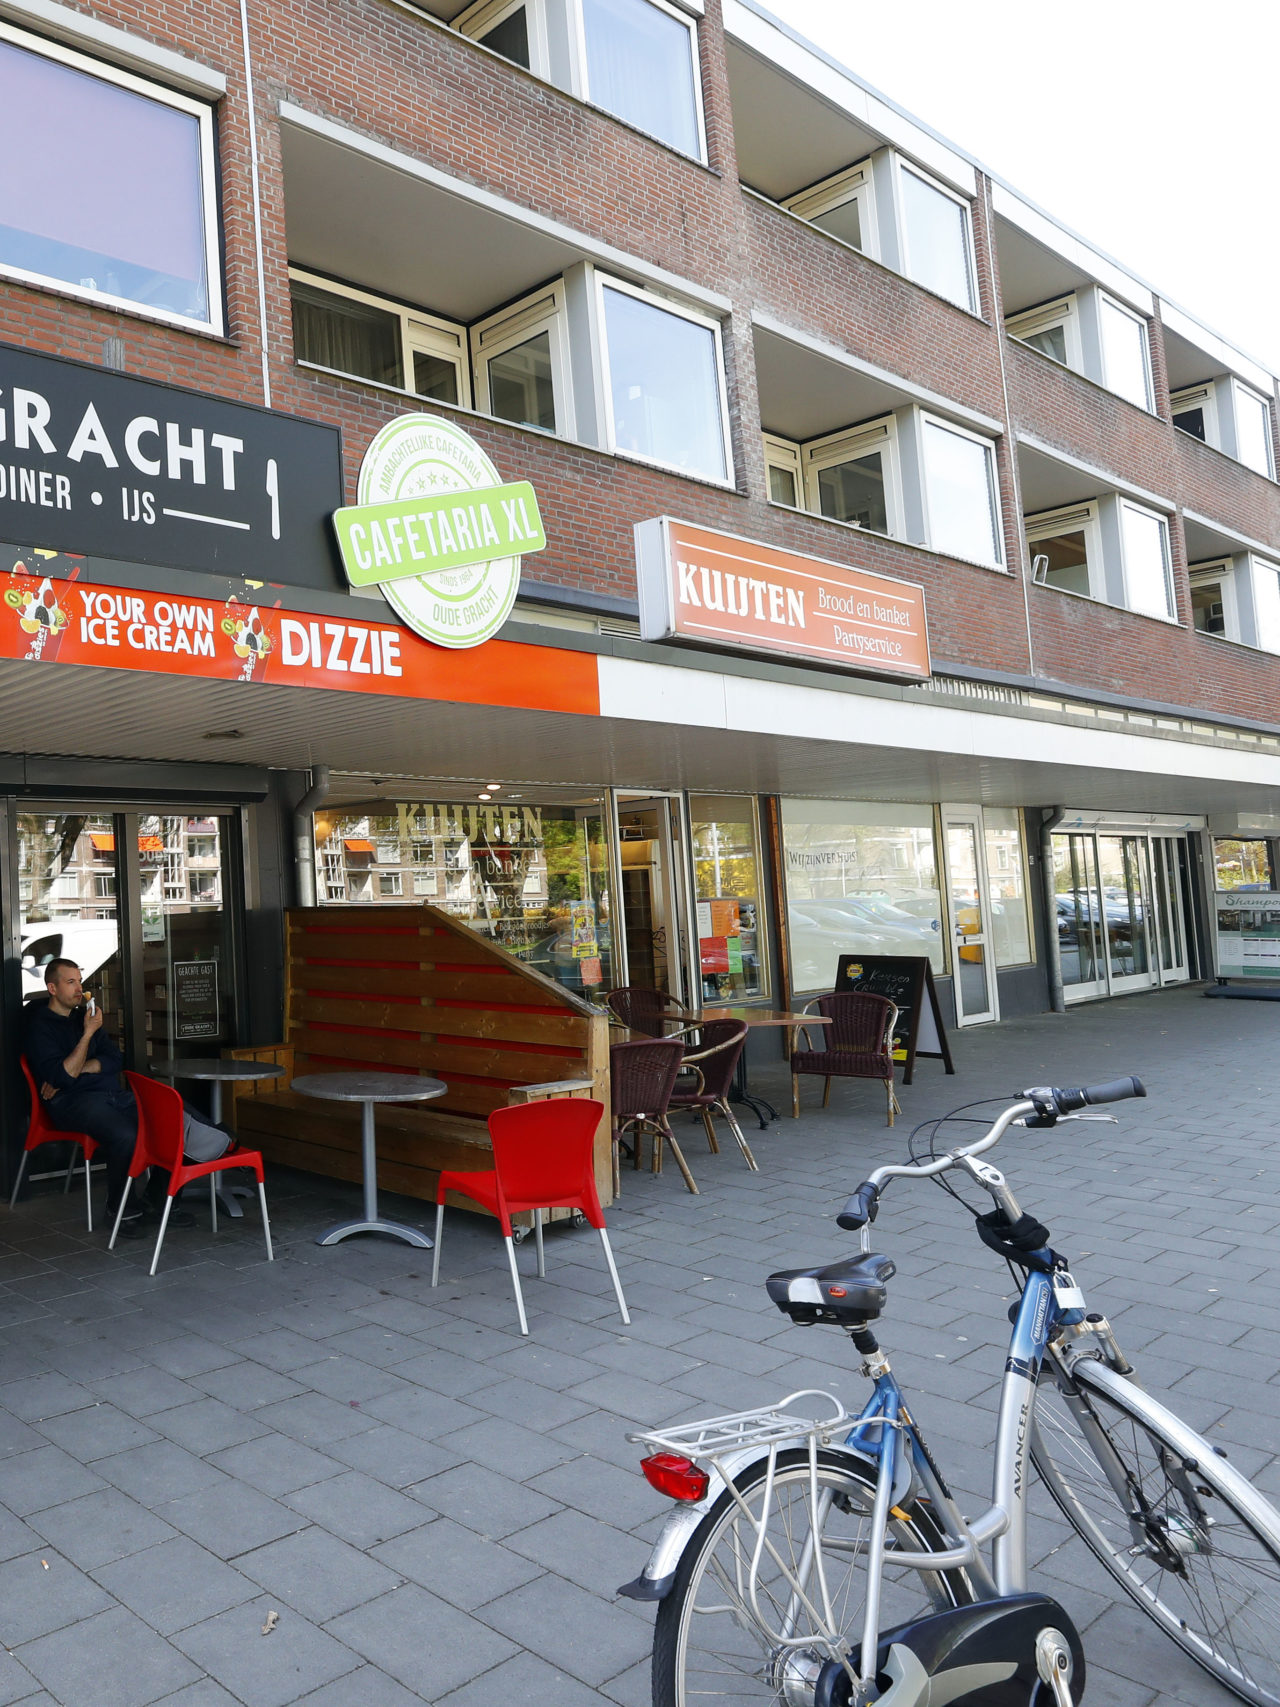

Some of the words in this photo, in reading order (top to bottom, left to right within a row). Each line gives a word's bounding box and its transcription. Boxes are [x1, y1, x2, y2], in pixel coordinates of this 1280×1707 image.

[379, 434, 434, 496] AMBACHTELIJKE
[436, 437, 483, 483] CAFETARIA
[122, 487, 157, 526] IJS
[349, 503, 501, 570] CAFETARIA
[500, 497, 539, 543] XL
[433, 603, 462, 627] OUDE
[463, 584, 499, 625] GRACHT
[677, 560, 807, 629] KUIJTEN
[818, 587, 854, 615] Brood
[856, 602, 871, 617] en
[873, 606, 911, 627] banket
[79, 590, 147, 624] YOUR
[153, 600, 215, 633] OWN
[280, 618, 403, 678] DIZZIE
[80, 616, 120, 647] ICE
[126, 623, 216, 657] CREAM
[834, 624, 903, 656] Partyservice
[395, 803, 543, 843] KUIJTEN
[178, 966, 200, 976] GEACHTE
[201, 965, 213, 974] GAST
[1014, 1403, 1029, 1499] AVANCER
